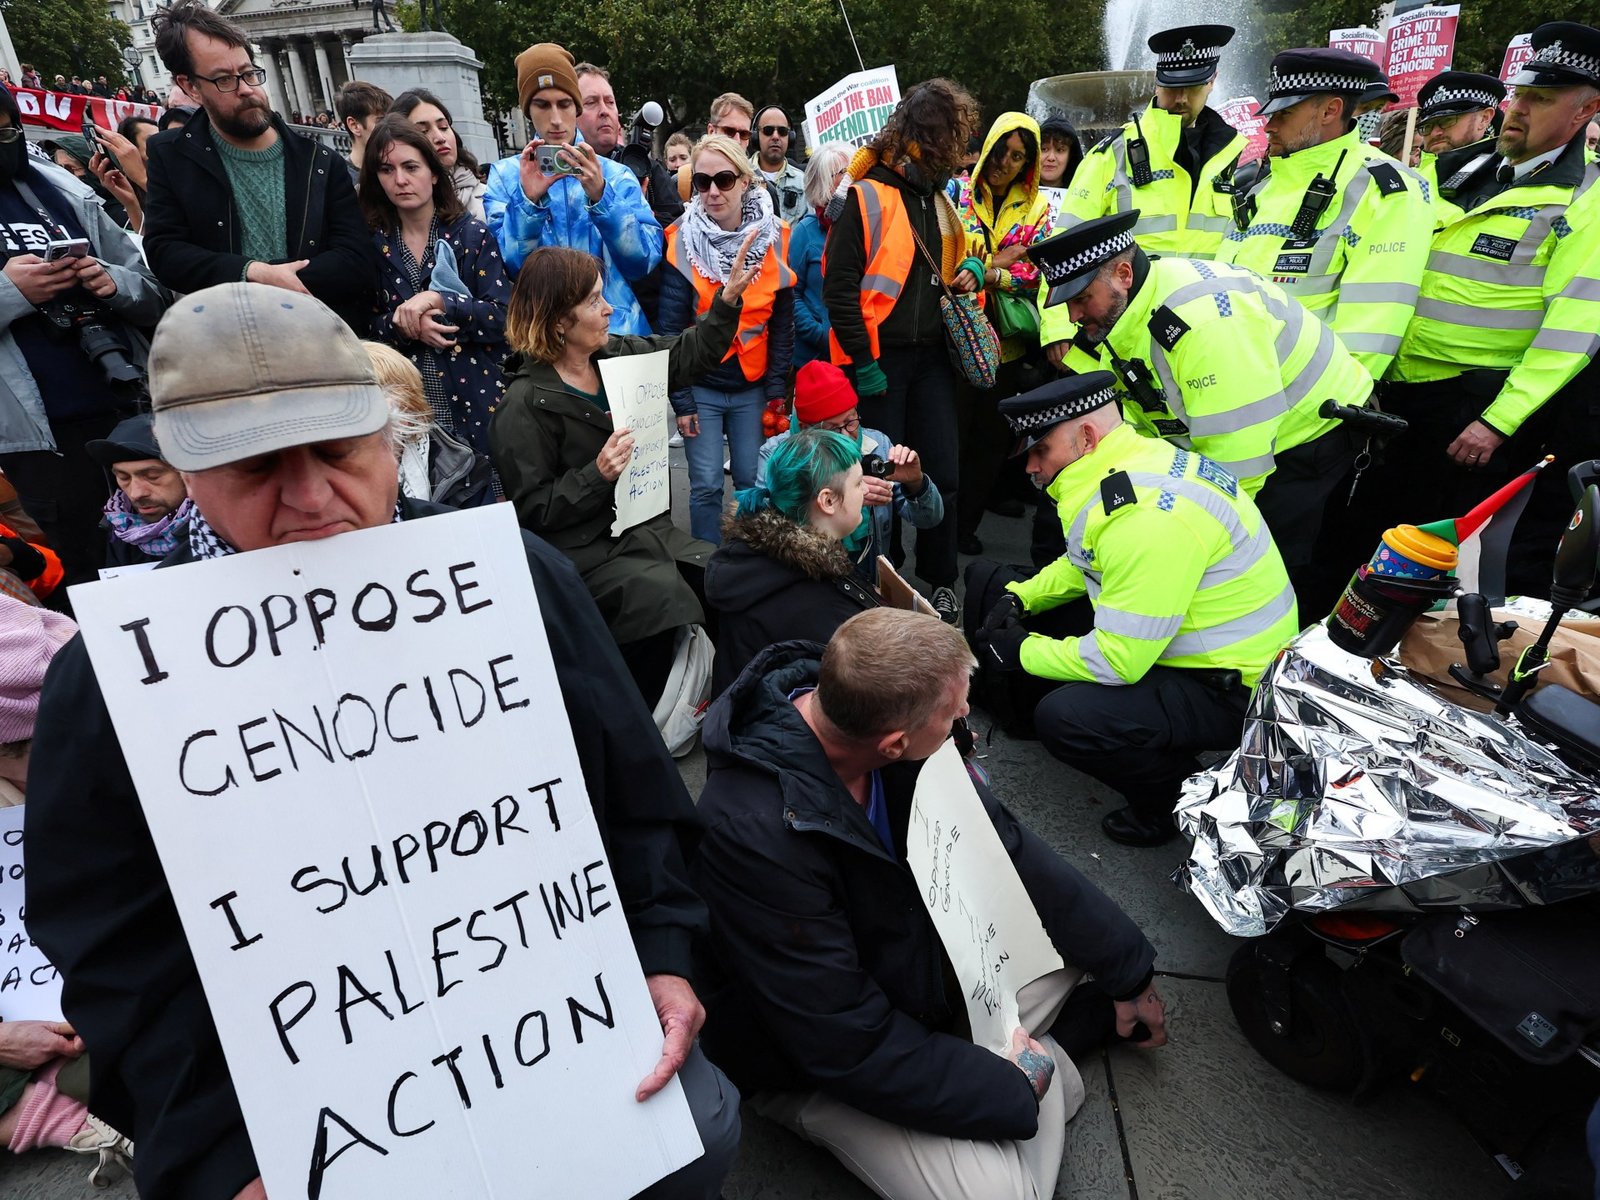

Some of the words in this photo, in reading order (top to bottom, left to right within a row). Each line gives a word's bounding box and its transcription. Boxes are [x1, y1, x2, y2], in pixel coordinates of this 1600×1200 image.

[1400, 11, 1428, 23] Socialist
[1429, 10, 1448, 18] Worker
[1393, 24, 1412, 40] IT'S
[1414, 20, 1435, 34] NOT
[1435, 19, 1441, 32] A
[1354, 41, 1369, 54] NOT
[1369, 43, 1375, 56] A
[1391, 35, 1422, 52] CRIME
[1427, 32, 1438, 46] TO
[1389, 51, 1408, 66] ACT
[1410, 45, 1449, 62] AGAINST
[1510, 47, 1534, 62] IT'S
[1388, 58, 1435, 77] GENOCIDE
[815, 102, 842, 133] DROP
[844, 90, 866, 115] THE
[866, 85, 894, 108] BAN
[1368, 241, 1406, 255] POLICE
[1165, 324, 1175, 336] AS
[1167, 326, 1182, 343] 2405
[629, 479, 664, 502] ACTION
[120, 618, 169, 686] I
[205, 561, 493, 668] OPPOSE
[179, 654, 530, 797] GENOCIDE
[210, 890, 264, 952] I
[290, 777, 563, 915] SUPPORT
[269, 859, 613, 1065] PALESTINE
[307, 971, 617, 1199] ACTION
